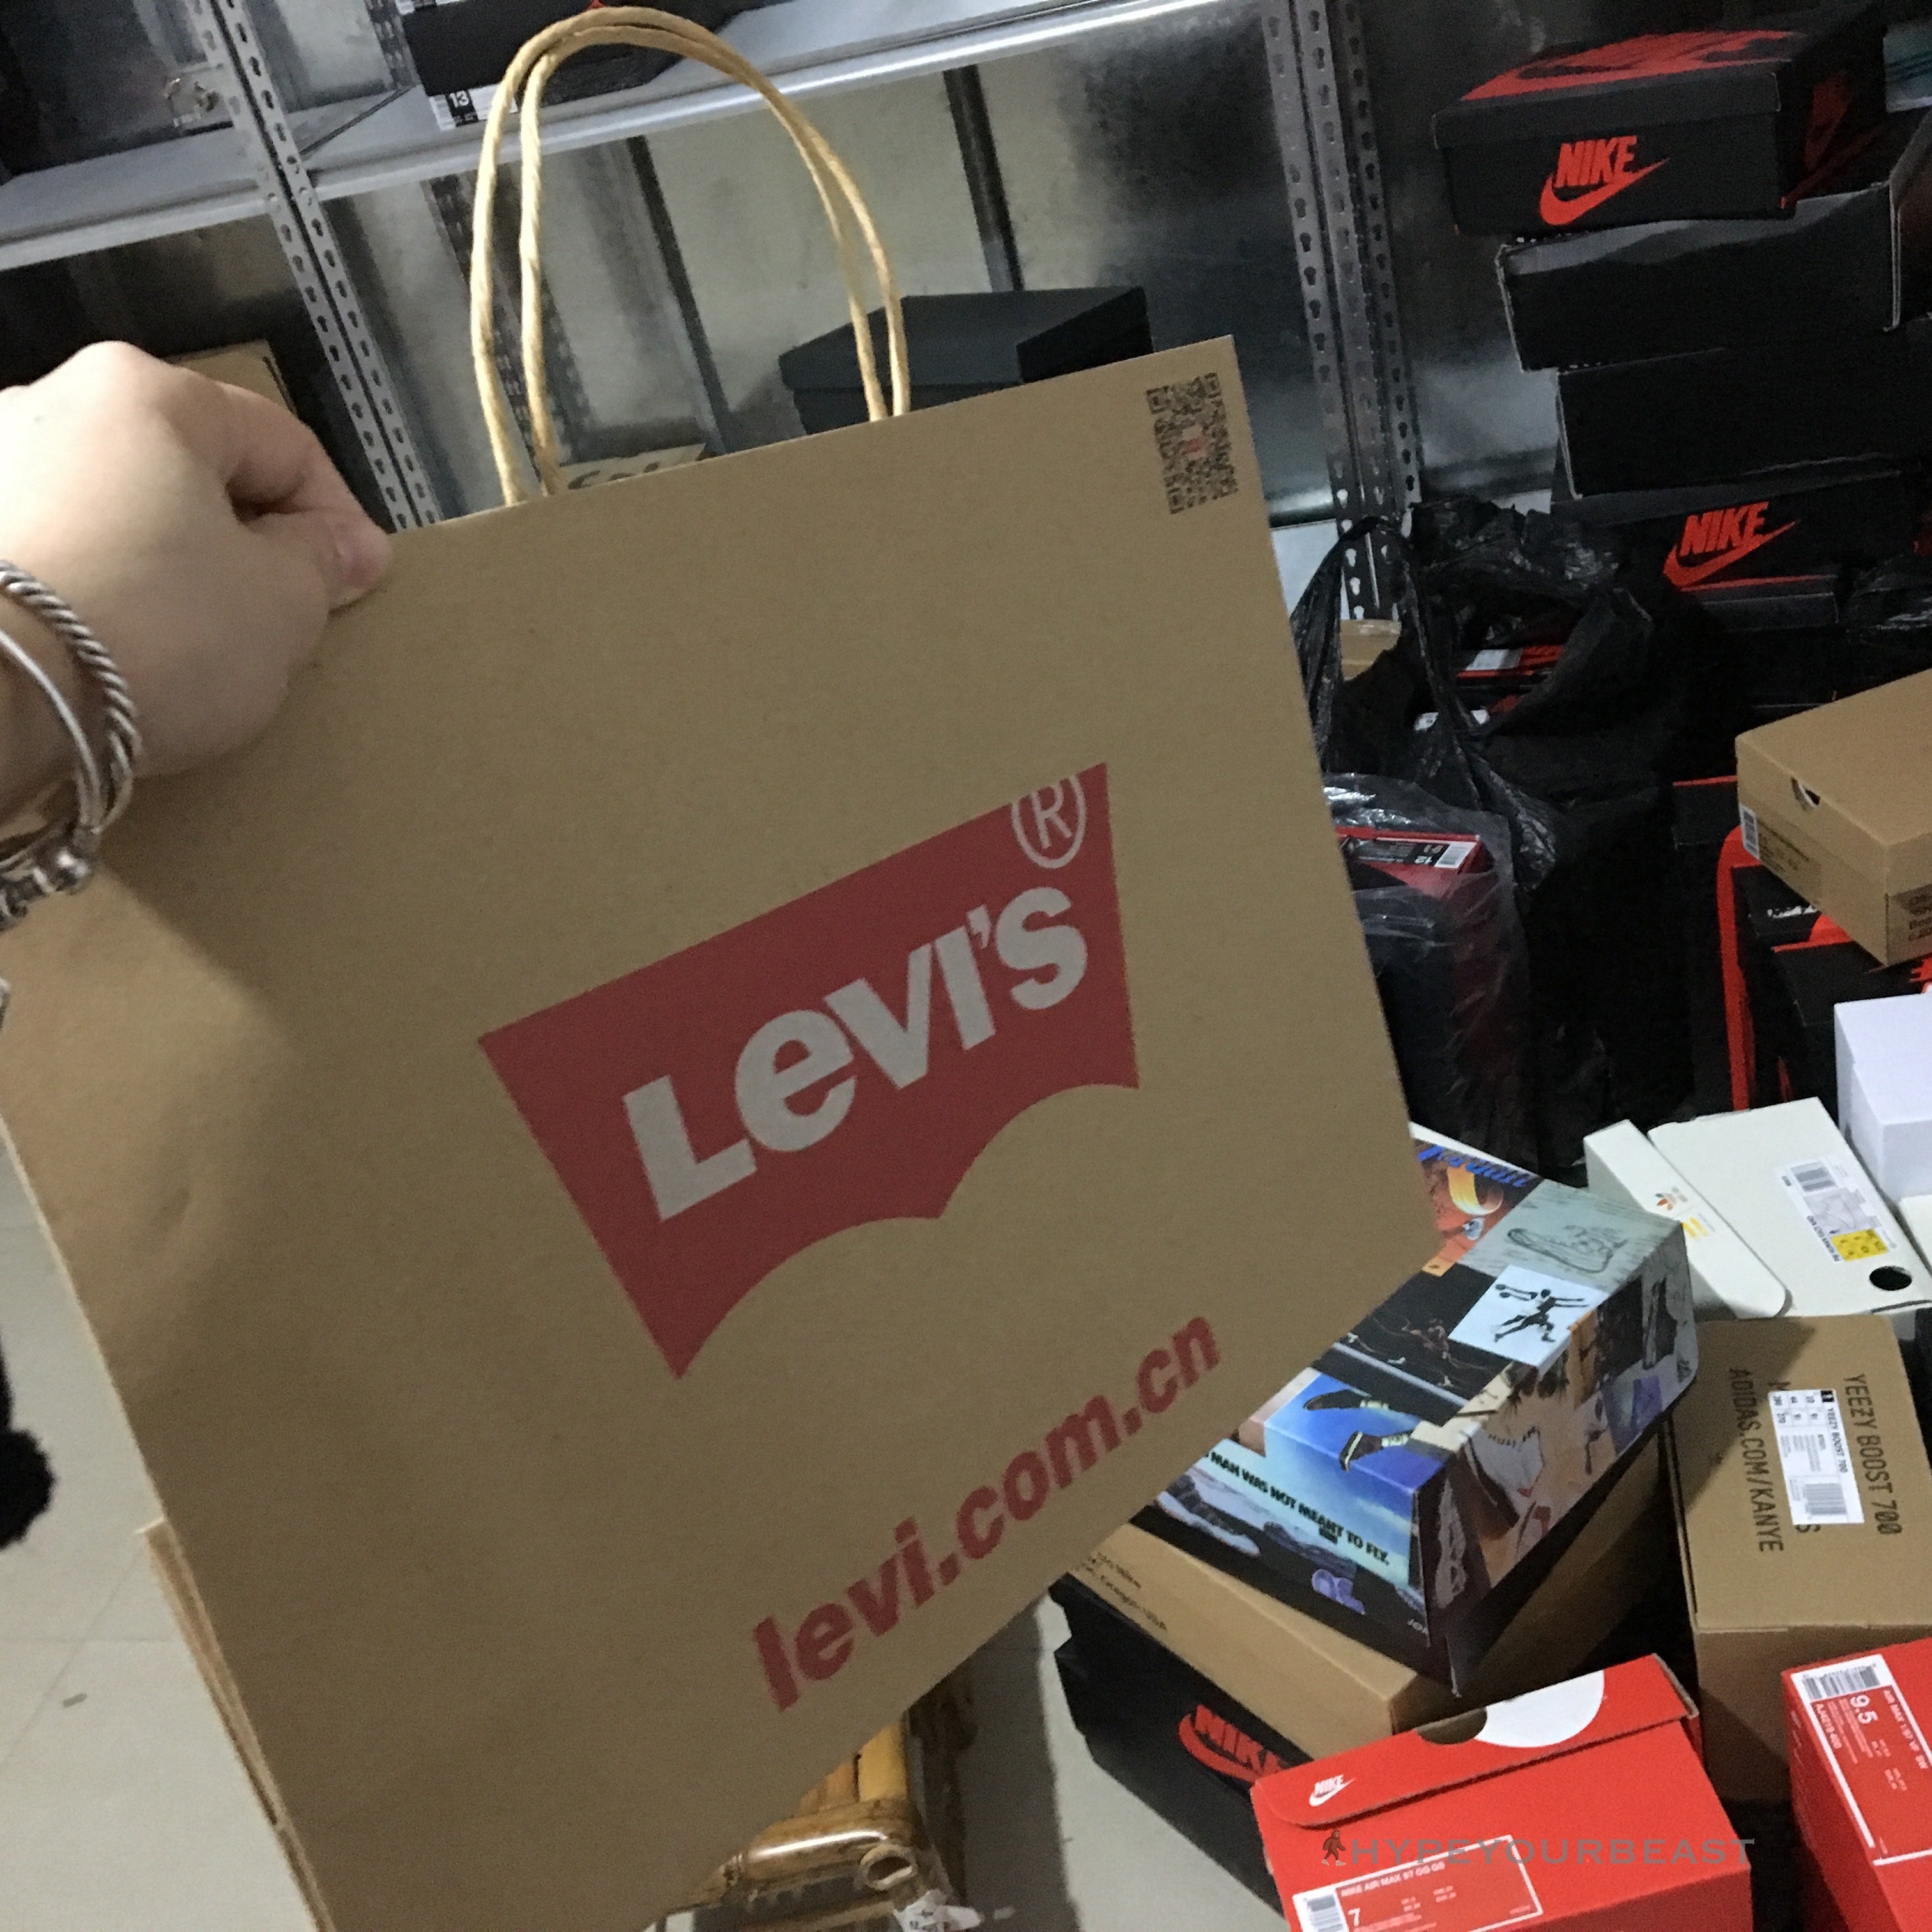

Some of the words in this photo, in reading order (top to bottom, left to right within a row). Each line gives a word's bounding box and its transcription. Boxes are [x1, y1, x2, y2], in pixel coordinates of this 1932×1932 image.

[449, 89, 470, 108] 13
[1556, 135, 1637, 187] NIKE
[1679, 502, 1770, 557] NIKE
[622, 886, 1089, 1222] Levi's
[1827, 1407, 1839, 1430] YEEZY
[1843, 1373, 1878, 1429] YEEZY
[1729, 1368, 1784, 1552] ADIDAS.COM/KANYE
[1832, 1432, 1844, 1457] BOOST
[1855, 1434, 1894, 1494] BOOST
[752, 1315, 1221, 1713] levi.com.cn
[1241, 1469, 1269, 1494] WAS
[1270, 1485, 1297, 1509] NOT
[1298, 1502, 1344, 1537] MEANT
[1345, 1529, 1363, 1549] TO
[1365, 1541, 1390, 1565] FLY.
[1871, 1499, 1903, 1535] 700
[1850, 1694, 1878, 1724] 9.5
[1314, 1774, 1344, 1797] NIKE
[1348, 1908, 1361, 1927] 7
